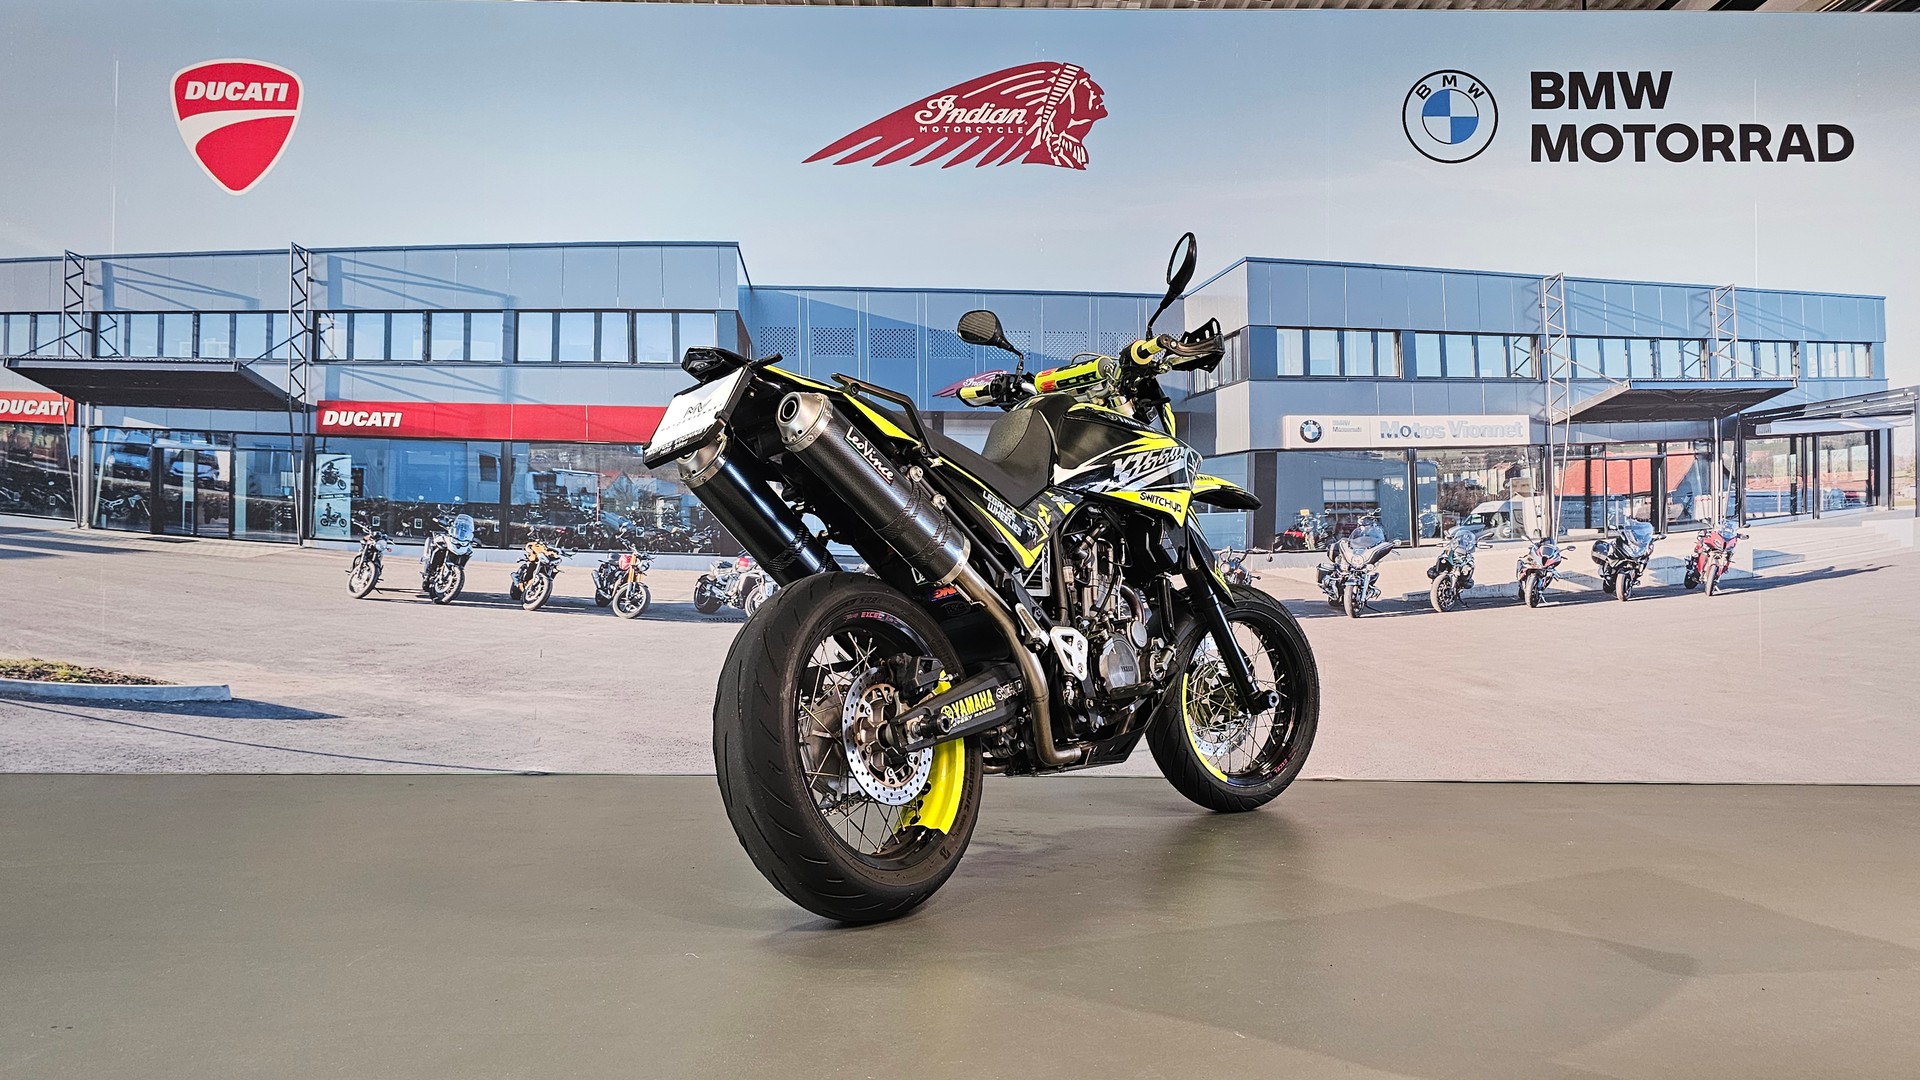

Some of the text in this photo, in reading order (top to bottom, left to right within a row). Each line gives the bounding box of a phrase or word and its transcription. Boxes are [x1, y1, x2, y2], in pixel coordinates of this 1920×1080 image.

[184, 81, 290, 102] DUCATI
[1415, 75, 1485, 100] BMW
[1531, 71, 1673, 110] BMW
[914, 94, 1028, 125] Indian
[919, 126, 1024, 134] MOTORCYCLE
[1531, 123, 1855, 163] MOTORRAD
[0, 399, 70, 416] DUCATI
[322, 410, 402, 427] DUCATI
[1380, 420, 1523, 439] Motos Vionnet
[845, 426, 894, 480] LeoVince
[951, 688, 996, 720] YAMAHA
